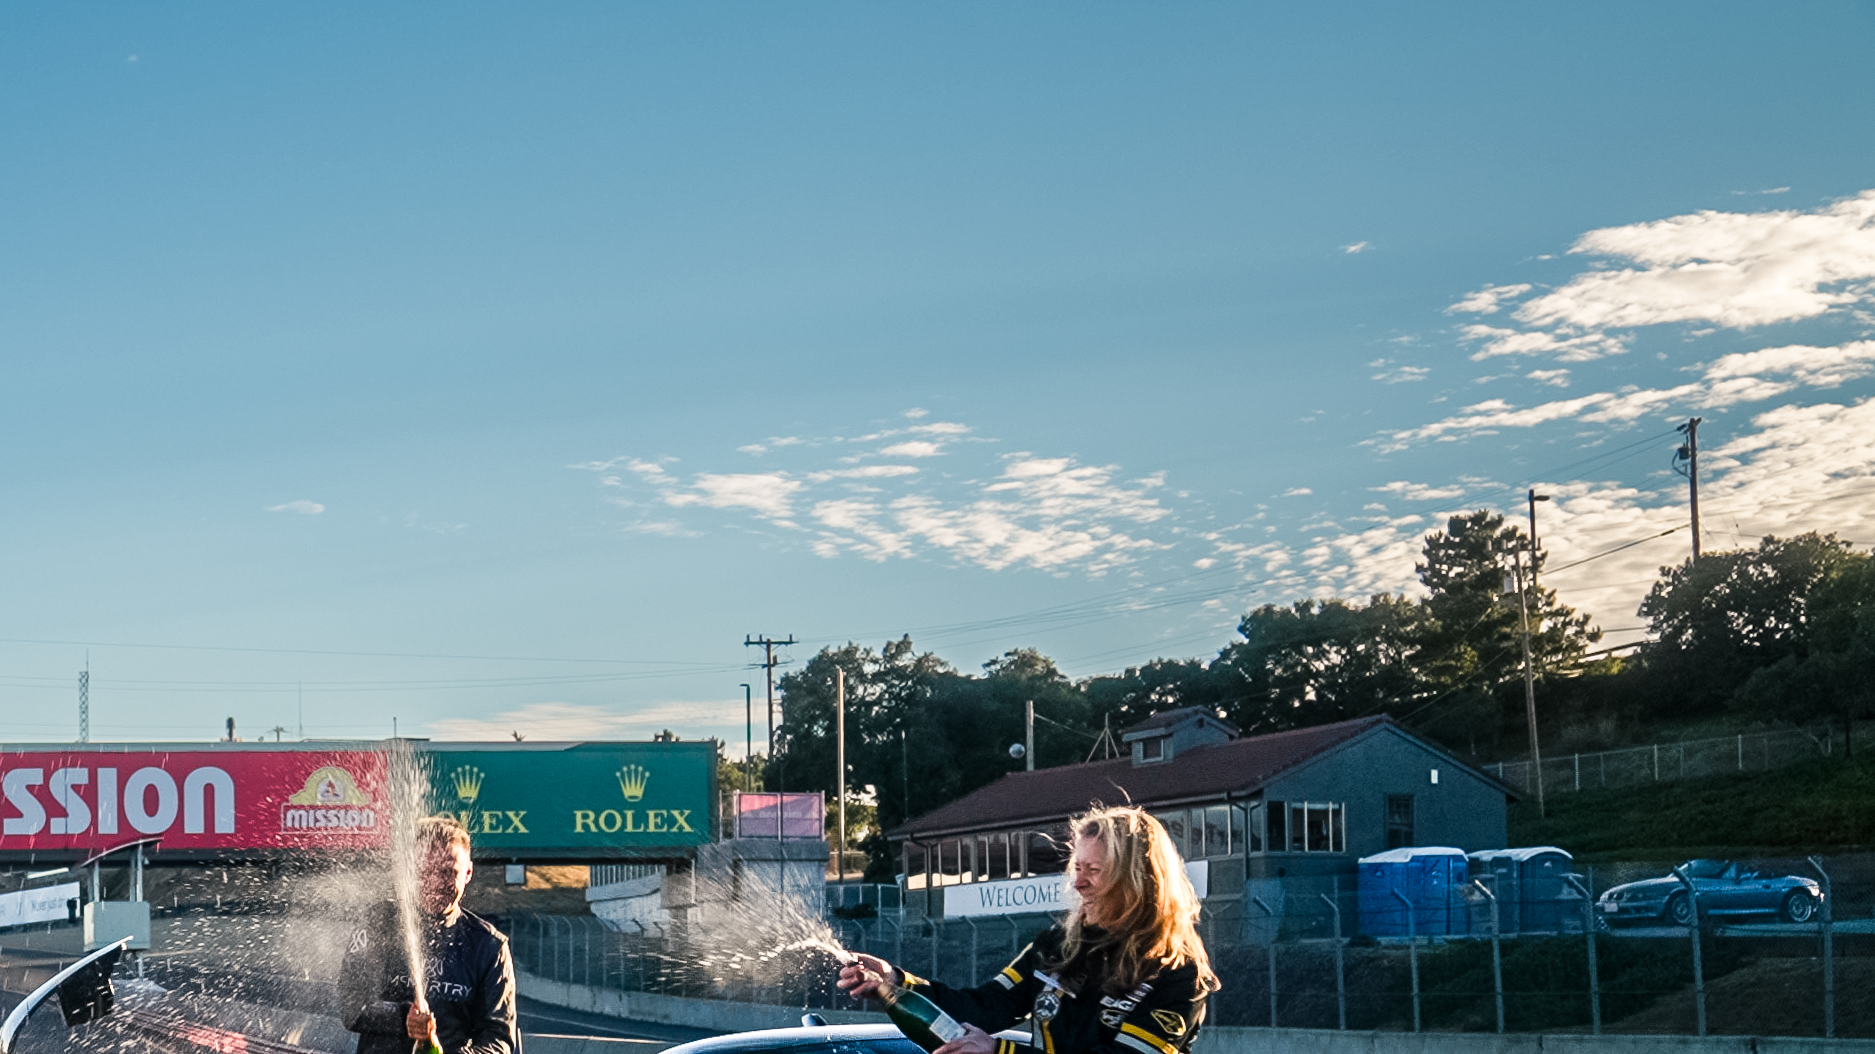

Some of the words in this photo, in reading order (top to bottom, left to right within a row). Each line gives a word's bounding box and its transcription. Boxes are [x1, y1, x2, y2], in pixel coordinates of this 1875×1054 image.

[285, 809, 375, 829] MISSION
[574, 809, 694, 833] ROLEX
[980, 883, 1061, 908] WELCOME
